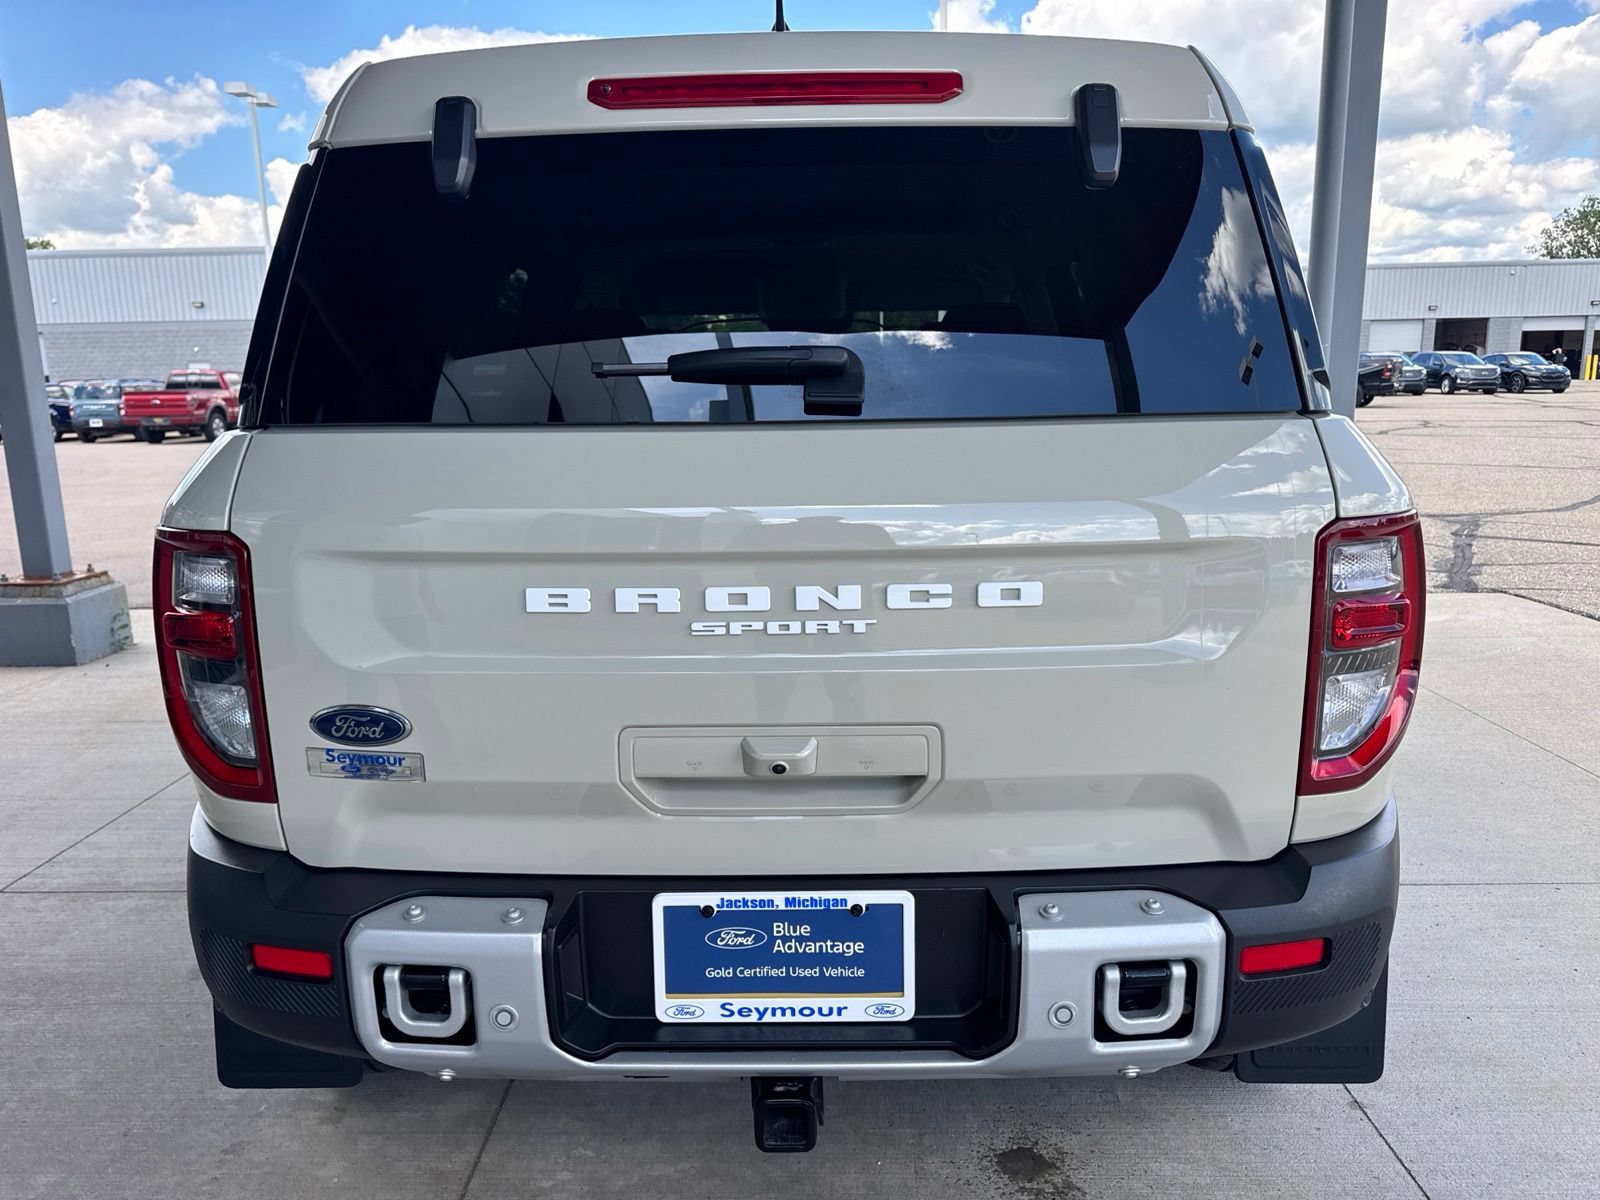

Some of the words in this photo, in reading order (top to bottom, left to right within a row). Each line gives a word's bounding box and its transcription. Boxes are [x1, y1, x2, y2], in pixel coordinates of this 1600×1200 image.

[525, 581, 1044, 613] BRONCO
[690, 618, 877, 636] SPORT
[331, 715, 385, 739] Ford
[324, 747, 406, 767] Seymour
[716, 897, 779, 910] Jackson,
[784, 896, 848, 911] Michigan
[716, 929, 755, 947] Ford
[773, 922, 811, 937] Blue
[772, 938, 865, 957] Advantage
[705, 967, 733, 979] Gold
[736, 966, 786, 978] Certified
[789, 966, 820, 978] Used
[822, 966, 865, 978] Vehicle
[672, 1006, 697, 1018] Ford
[720, 1002, 849, 1022] Seymour
[872, 1005, 898, 1017] Ford
